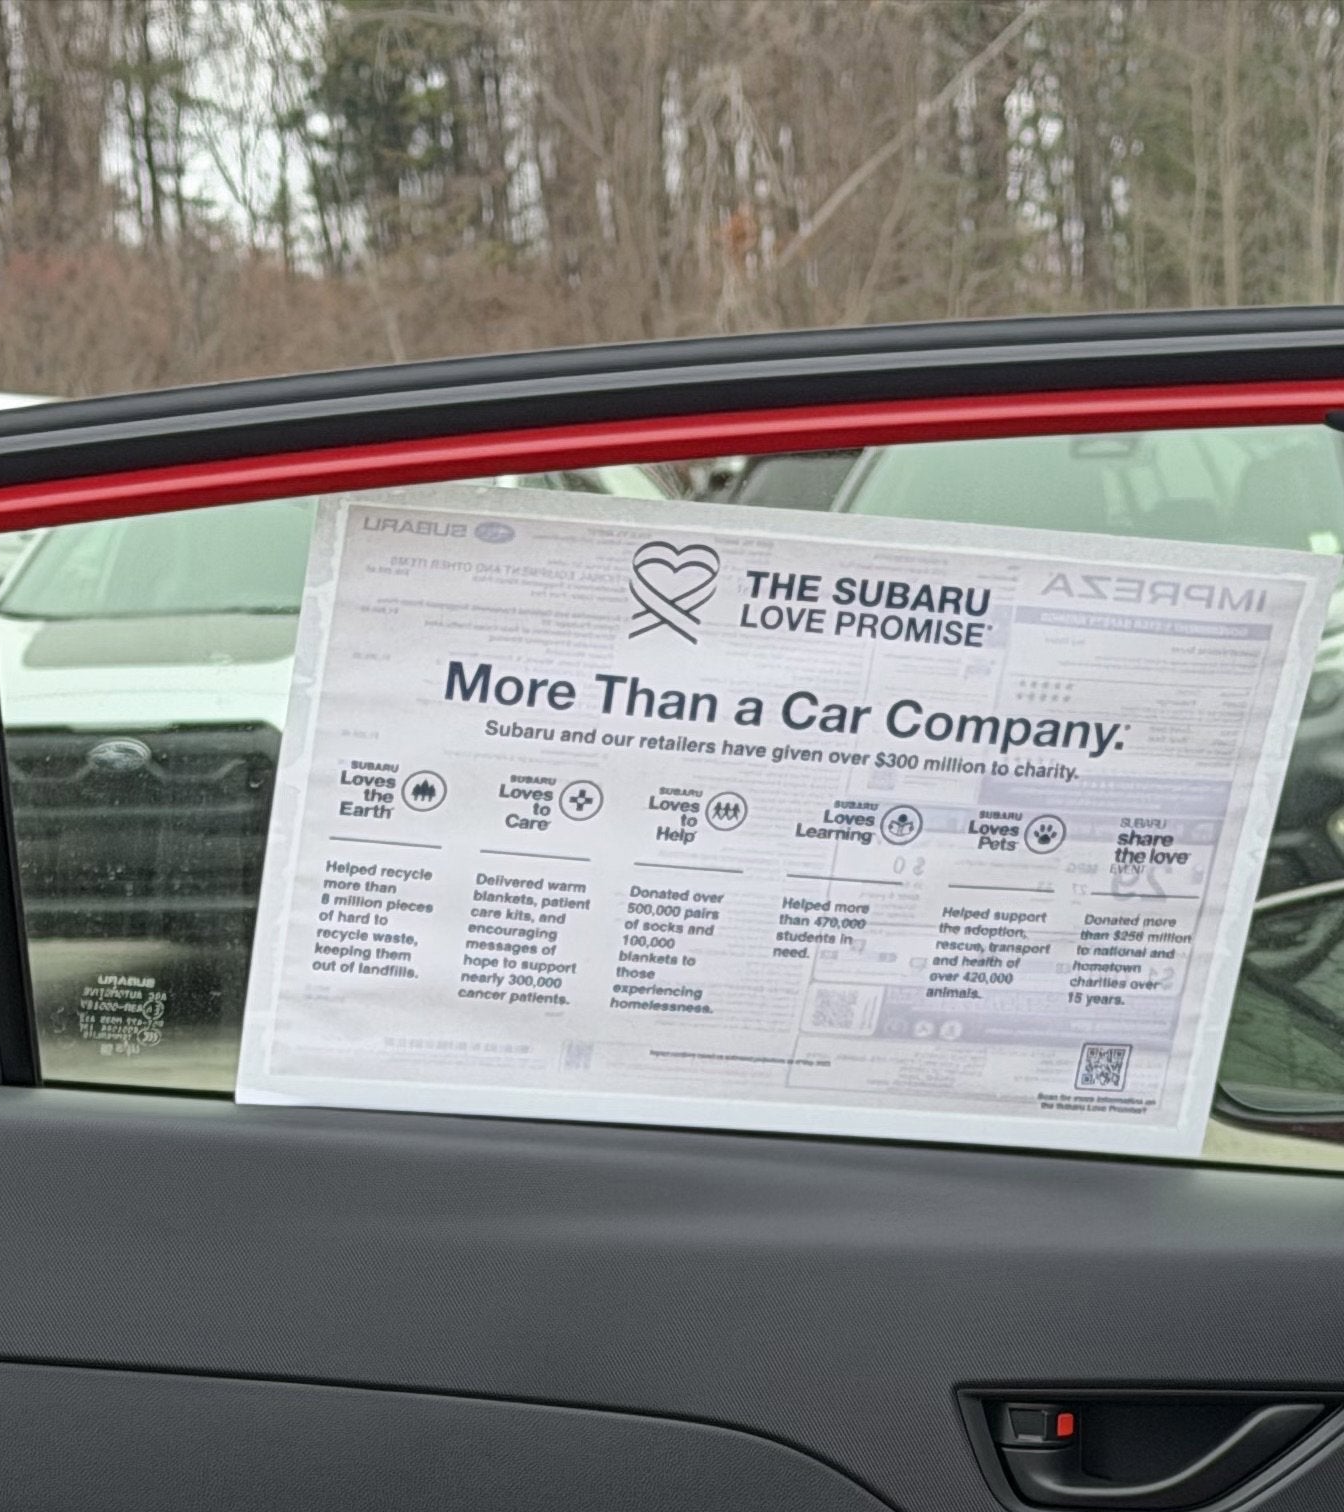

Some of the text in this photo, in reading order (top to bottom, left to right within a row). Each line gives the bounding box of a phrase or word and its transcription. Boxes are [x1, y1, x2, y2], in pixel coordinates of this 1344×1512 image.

[746, 571, 991, 617] THE SUBARU
[740, 603, 824, 632] LOVE
[444, 660, 576, 711] More
[594, 673, 718, 722] Than
[734, 696, 764, 728] a
[782, 690, 871, 734] Car
[484, 719, 1080, 783] Subaru and our retailers have given over $300 million to charity.
[351, 760, 399, 773] SUBARU
[340, 771, 396, 789] Loves
[510, 774, 557, 786] SUBARU
[364, 788, 394, 803] the
[499, 784, 553, 800] Loves
[659, 787, 703, 798] SUBARU
[339, 802, 392, 819] Earth
[533, 802, 551, 816] to
[649, 796, 700, 812] Loves
[834, 800, 879, 811] SUBARU
[505, 814, 549, 830] Care
[681, 814, 698, 827] to
[824, 810, 875, 826] Loves
[979, 810, 1023, 821] SUBARU
[1120, 818, 1166, 829] SUBARU
[656, 826, 696, 845] Help
[796, 824, 873, 845] Learning
[968, 820, 1019, 836] Loves
[978, 836, 1016, 851] Pets
[1117, 830, 1174, 846] share
[1114, 848, 1189, 864] the love
[326, 860, 432, 882] Helped recycle
[324, 880, 397, 894] more than
[476, 872, 586, 893] Delivered warm
[473, 890, 590, 911] blankets, patient
[630, 885, 724, 904] Donated over
[334, 894, 382, 909] million
[386, 900, 434, 914] pieces
[628, 902, 719, 920] 500,000 pairs
[782, 897, 870, 914] Helped more
[319, 910, 388, 926] of hard to
[470, 908, 566, 925] care kits, and
[780, 914, 809, 926] than
[942, 906, 1046, 924] Helped support
[1084, 914, 1176, 928] Donated more
[468, 924, 558, 942] encouraging
[624, 920, 714, 936] of socks and
[939, 922, 1027, 940] the adoption,
[316, 927, 418, 947] recycle waste,
[623, 935, 675, 950] 100,000
[776, 930, 853, 946] students in
[1080, 930, 1110, 940] than
[1148, 933, 1192, 945] million
[314, 942, 412, 962] keeping them
[466, 940, 556, 956] messages of
[773, 946, 810, 960] need.
[936, 940, 1050, 956] rescue, transport
[1076, 945, 1174, 960] to national and
[463, 954, 576, 975] hope to support
[618, 950, 696, 966] blankets to
[932, 955, 1020, 969] and health of
[312, 960, 419, 979] out of landfills.
[616, 966, 656, 980] those
[1072, 960, 1142, 974] hometown
[460, 972, 562, 990] nearly 300,000
[929, 972, 1013, 986] over 420,000
[1070, 976, 1160, 991] charities over
[458, 988, 570, 1006] cancer patients.
[612, 982, 702, 1000] experiencing
[926, 986, 981, 1000] animals.
[610, 997, 713, 1014] homelessness.
[1068, 992, 1124, 1007] 15 years.
